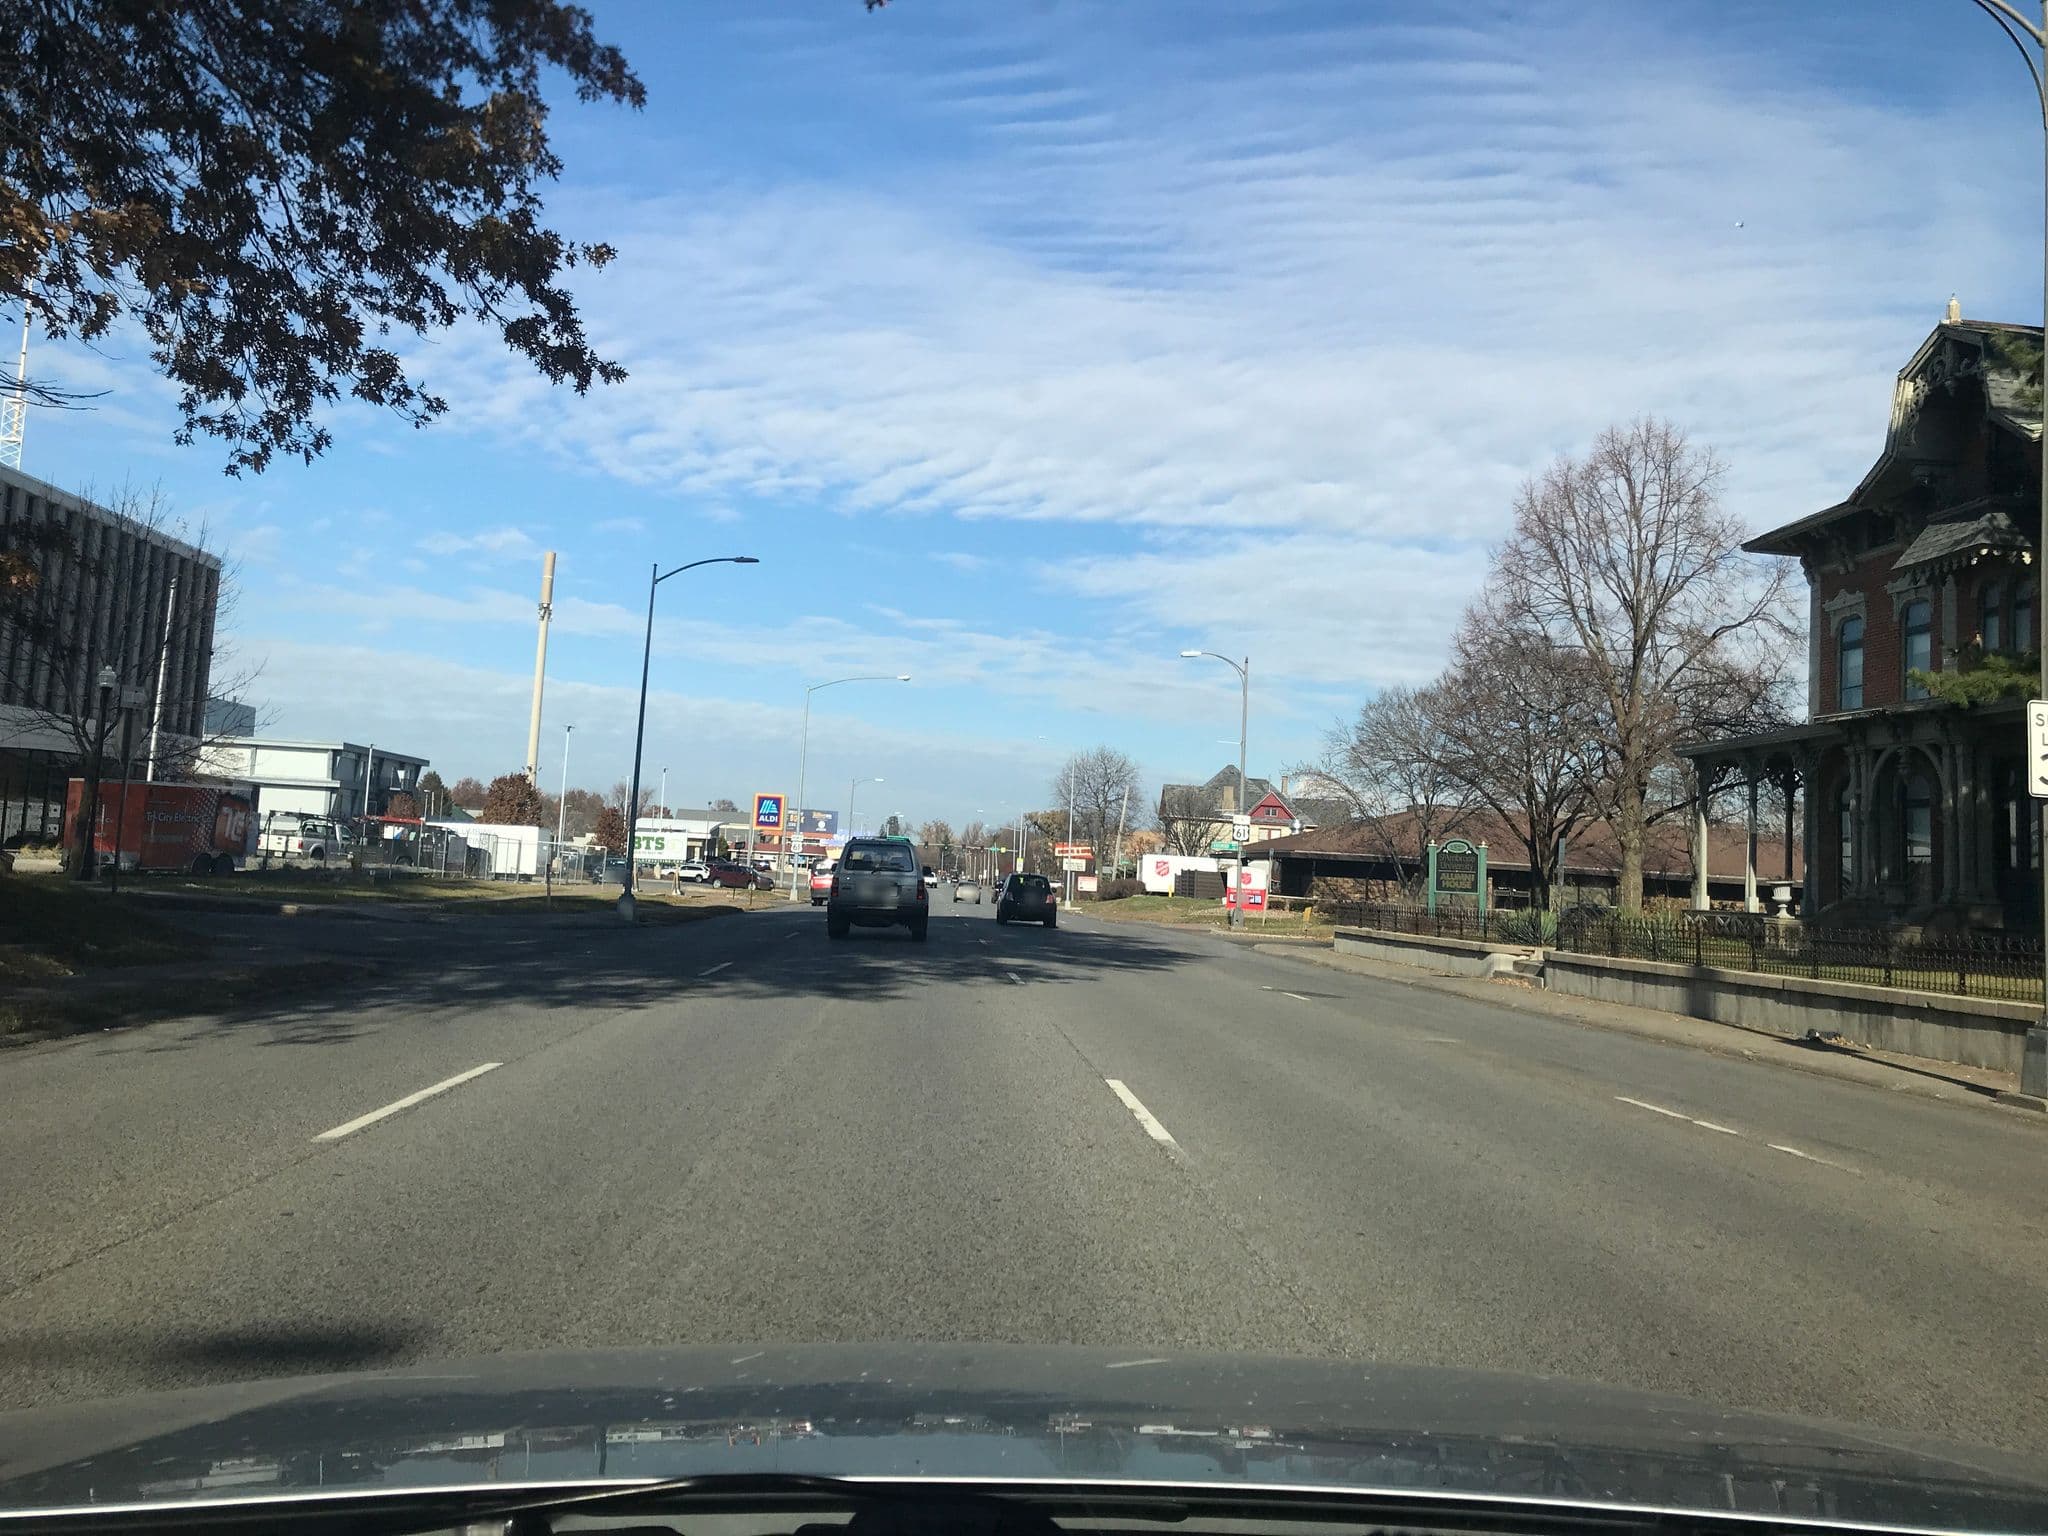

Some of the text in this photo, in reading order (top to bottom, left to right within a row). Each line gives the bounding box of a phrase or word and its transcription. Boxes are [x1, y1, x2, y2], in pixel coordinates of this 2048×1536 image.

[1236, 828, 1246, 838] 61
[1440, 873, 1475, 882] ALUMNI
[1442, 880, 1472, 889] HOUSE
